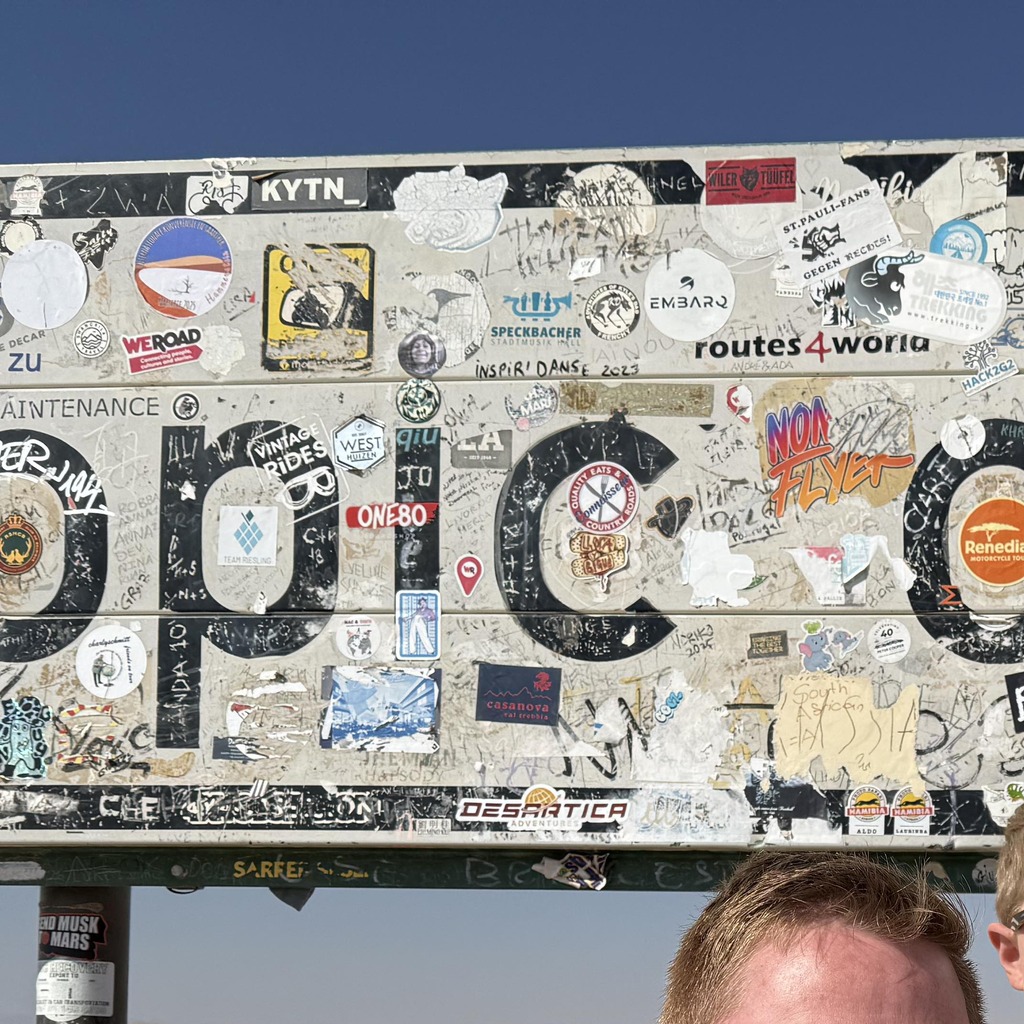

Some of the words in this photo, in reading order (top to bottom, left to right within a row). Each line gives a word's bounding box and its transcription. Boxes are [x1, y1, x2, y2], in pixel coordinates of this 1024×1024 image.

[708, 173, 737, 187] WILER
[803, 257, 841, 281] GEGEN
[650, 295, 728, 310] EMBARQ
[491, 326, 581, 339] SPECKBACHER
[597, 330, 632, 341] FRENCHY
[122, 328, 202, 354] WEROAD
[491, 338, 554, 347] STADTMUSIK
[602, 364, 640, 377] 2023
[962, 359, 1015, 391] HACK2G2
[254, 423, 321, 460] VINTAGE
[340, 436, 381, 451] WEST
[571, 473, 588, 509] QUALITY
[590, 466, 612, 476] EATS
[615, 470, 621, 478] &
[625, 485, 636, 516] ROADS
[358, 502, 427, 529] ONE80
[586, 518, 626, 532] COUNTRY
[223, 556, 243, 564] TEAM
[243, 556, 272, 565] RIESLING
[881, 628, 894, 637] 40
[487, 700, 550, 713] casanova
[894, 808, 931, 816] NAMIBIA
[511, 820, 579, 828] ADVENTURES
[57, 916, 100, 934] MUSK
[50, 931, 91, 951] MARS
